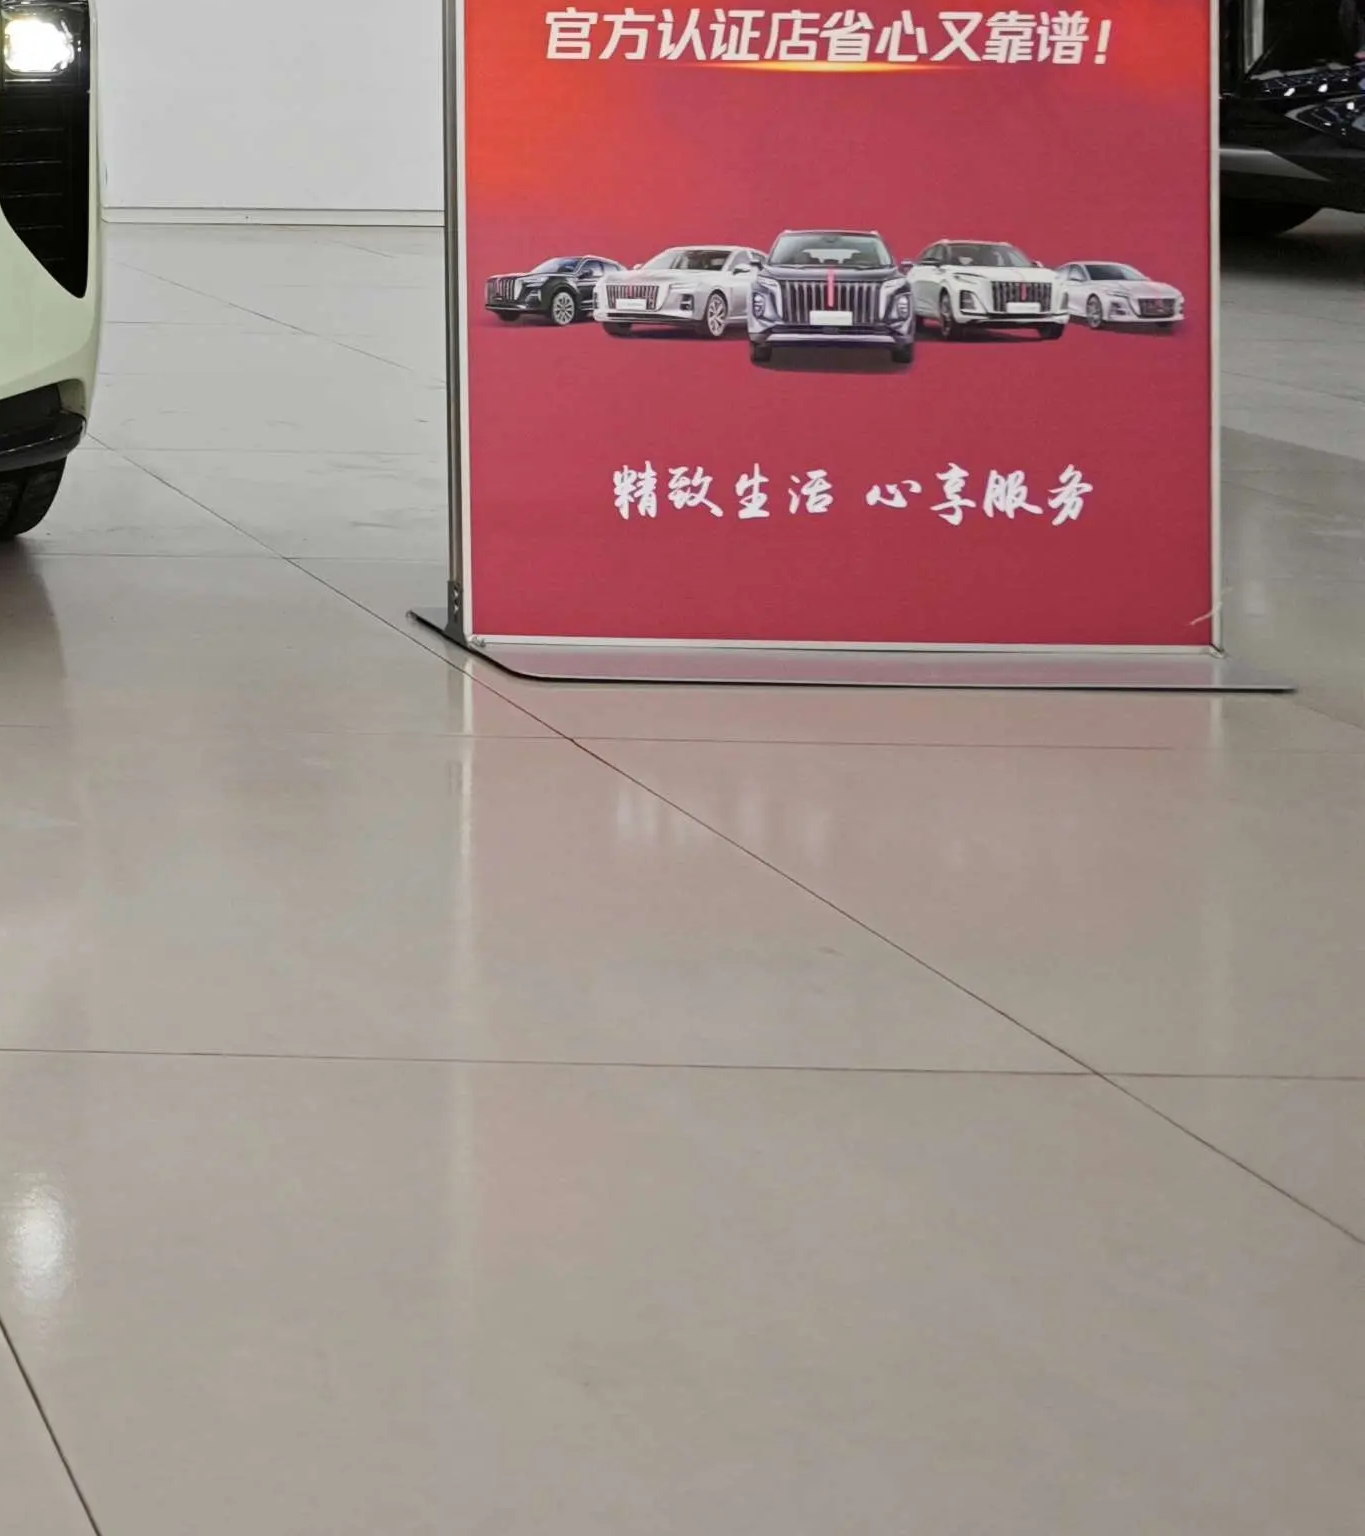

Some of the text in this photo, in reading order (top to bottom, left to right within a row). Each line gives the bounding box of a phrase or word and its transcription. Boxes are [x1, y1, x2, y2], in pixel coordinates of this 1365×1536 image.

[612, 460, 1094, 527] 精致生活 心享服务
